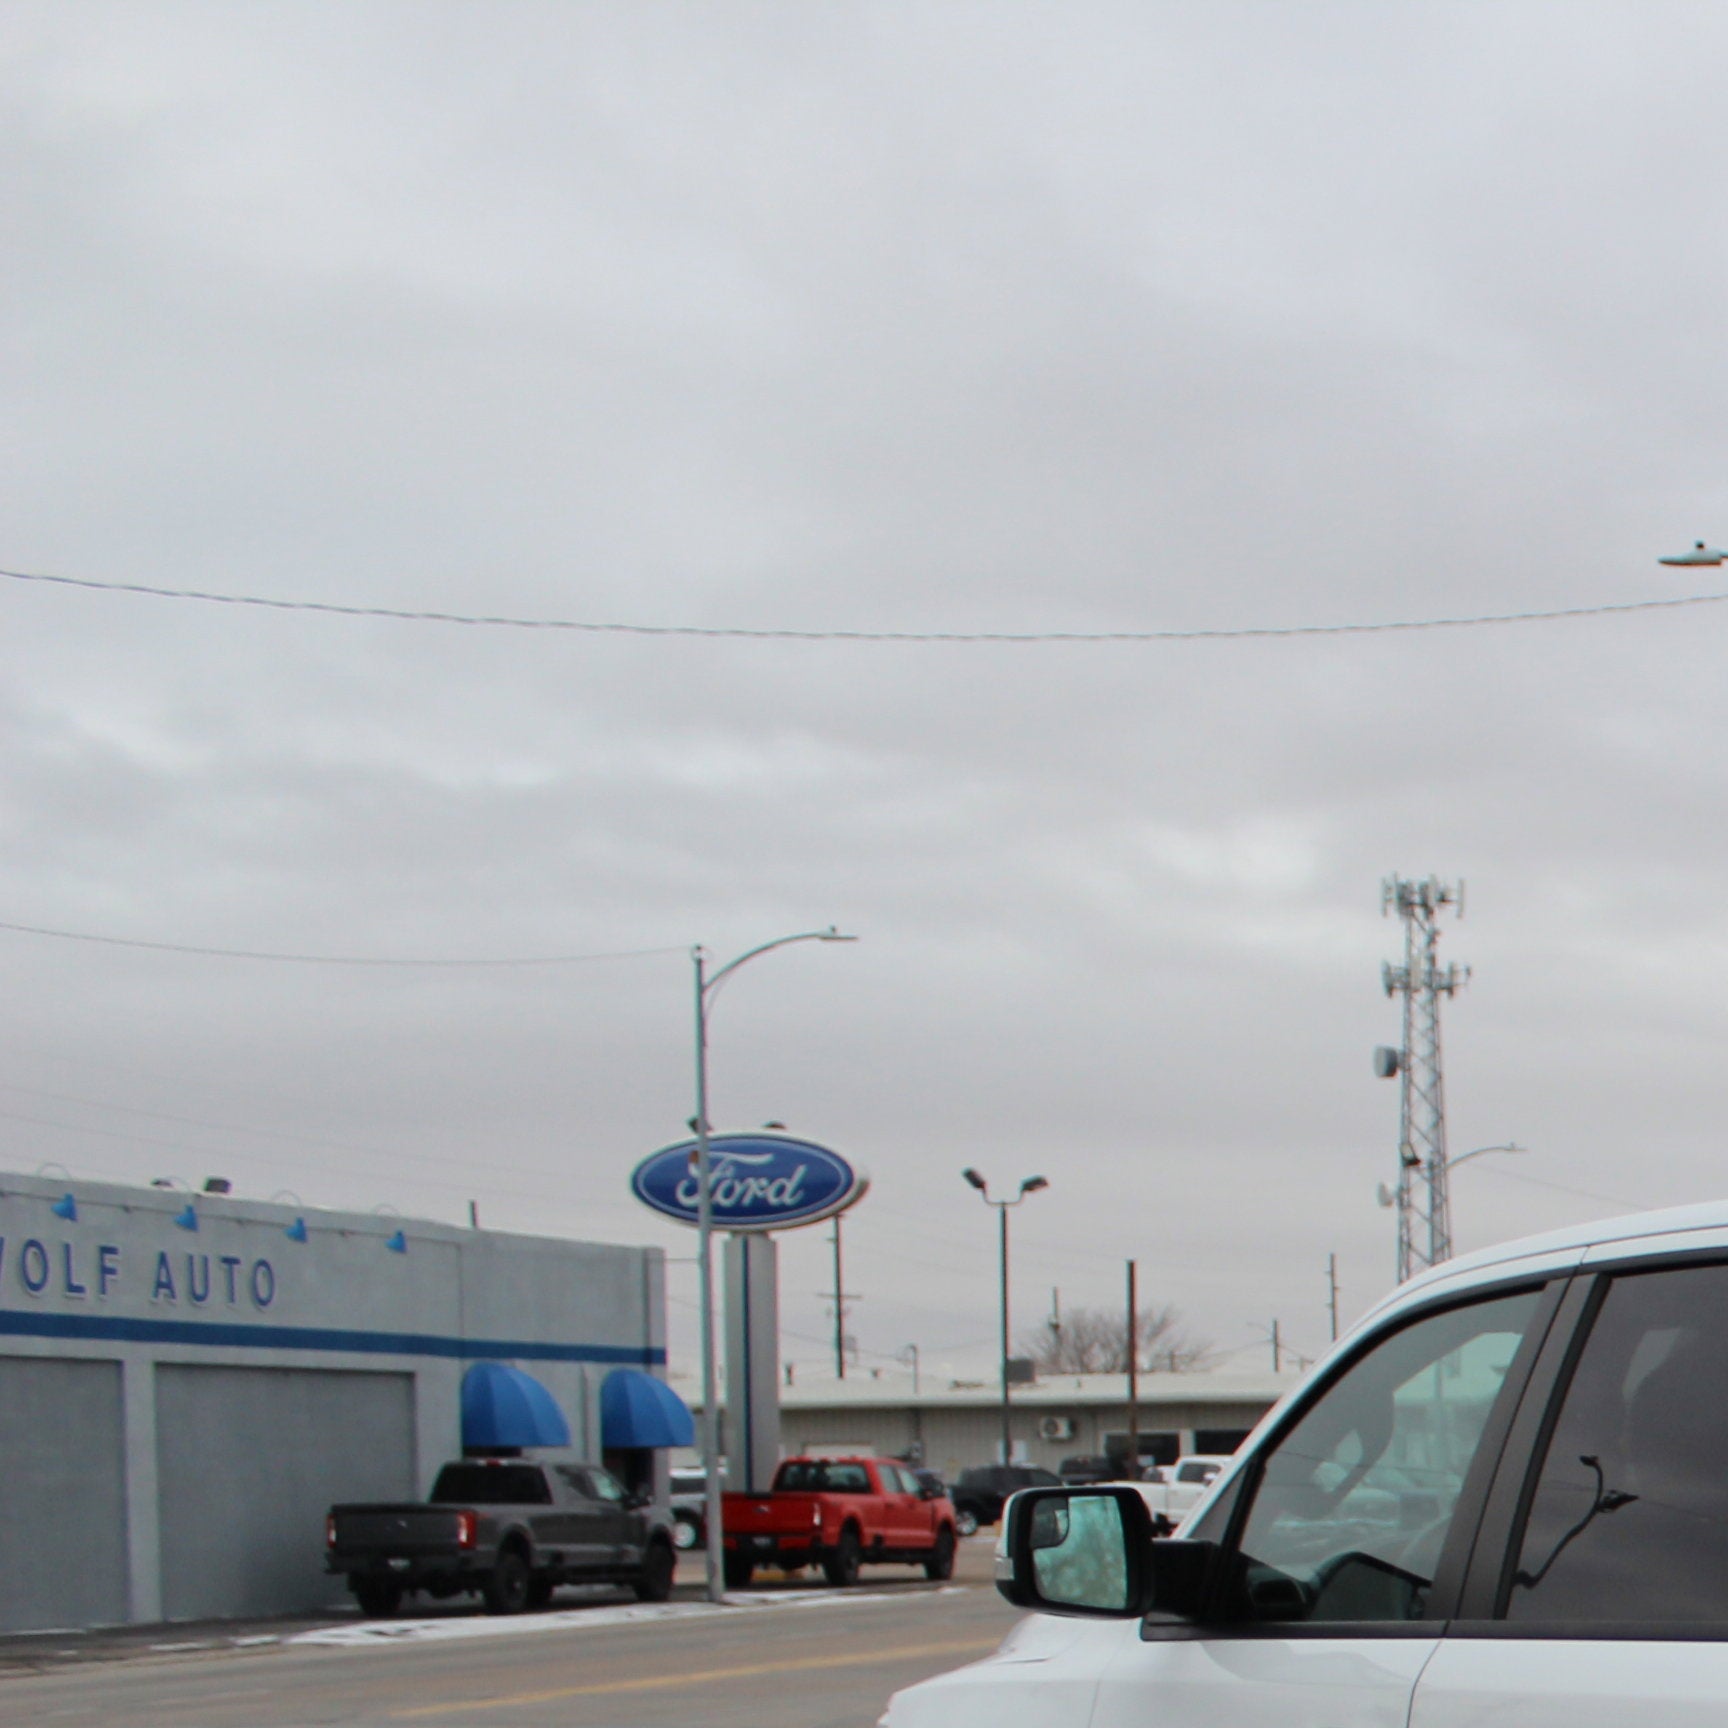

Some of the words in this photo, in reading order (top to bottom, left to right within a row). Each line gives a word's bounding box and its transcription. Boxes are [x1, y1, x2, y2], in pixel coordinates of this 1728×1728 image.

[675, 1151, 807, 1208] Ford
[0, 1236, 119, 1297] OLF
[154, 1251, 275, 1307] AUTO
